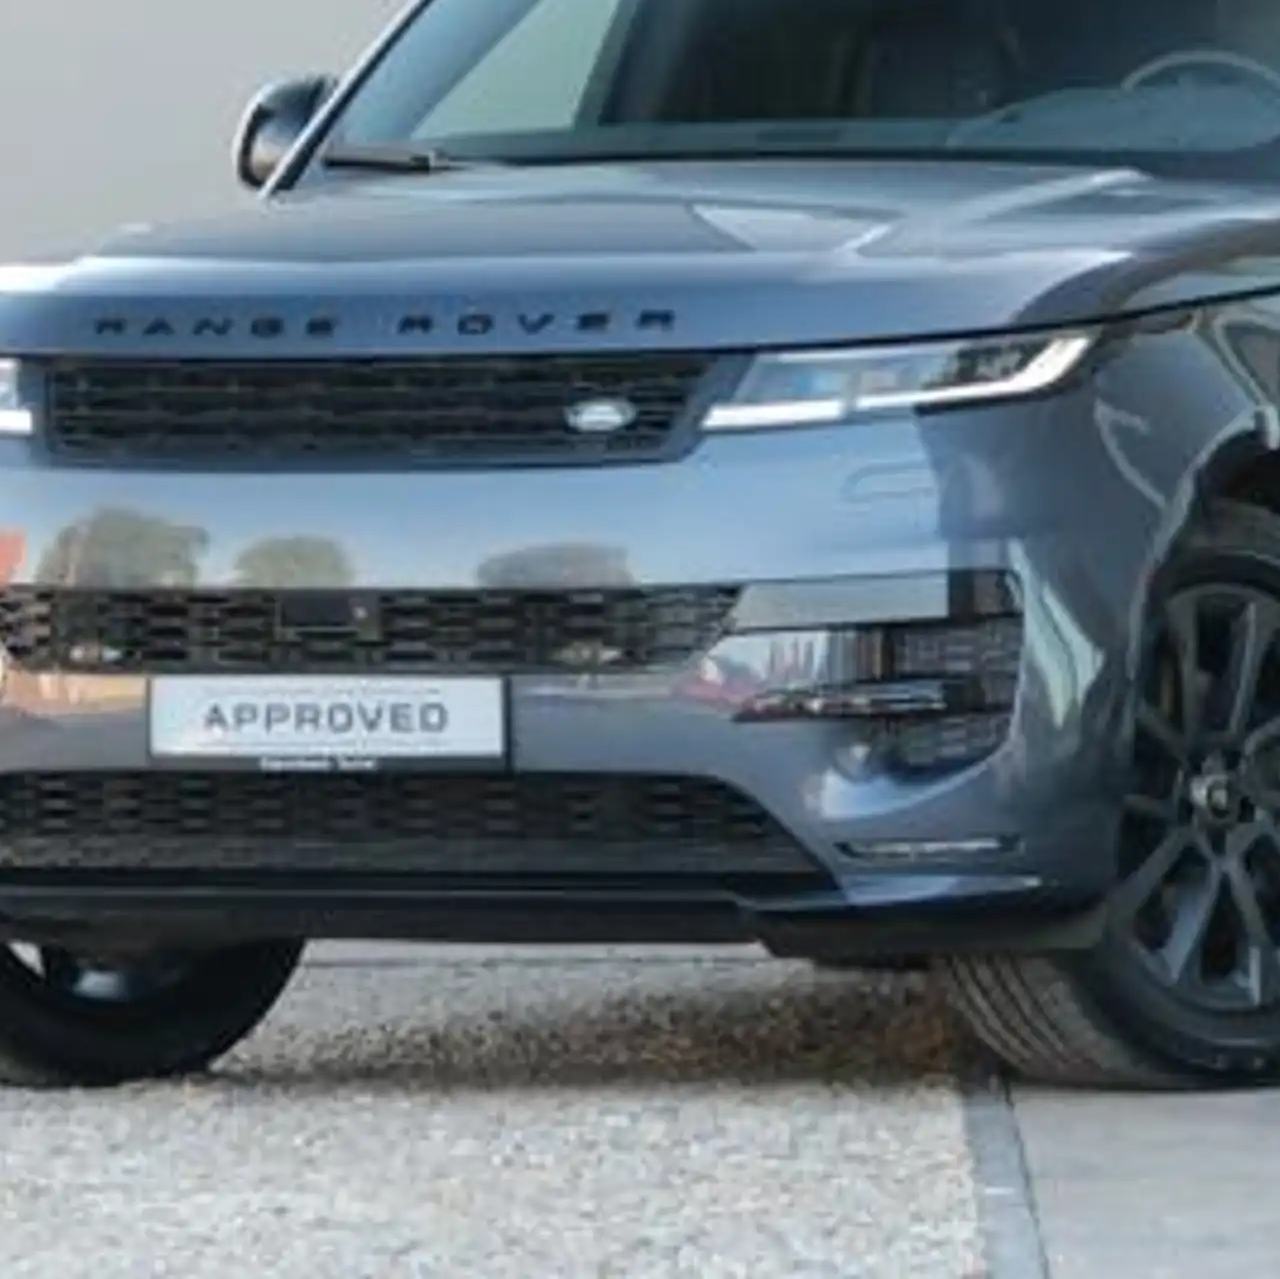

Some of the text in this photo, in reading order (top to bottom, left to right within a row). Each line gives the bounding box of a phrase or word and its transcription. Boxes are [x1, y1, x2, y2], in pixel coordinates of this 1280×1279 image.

[95, 309, 676, 337] RANGE ROVER
[201, 701, 450, 734] APPROVED
